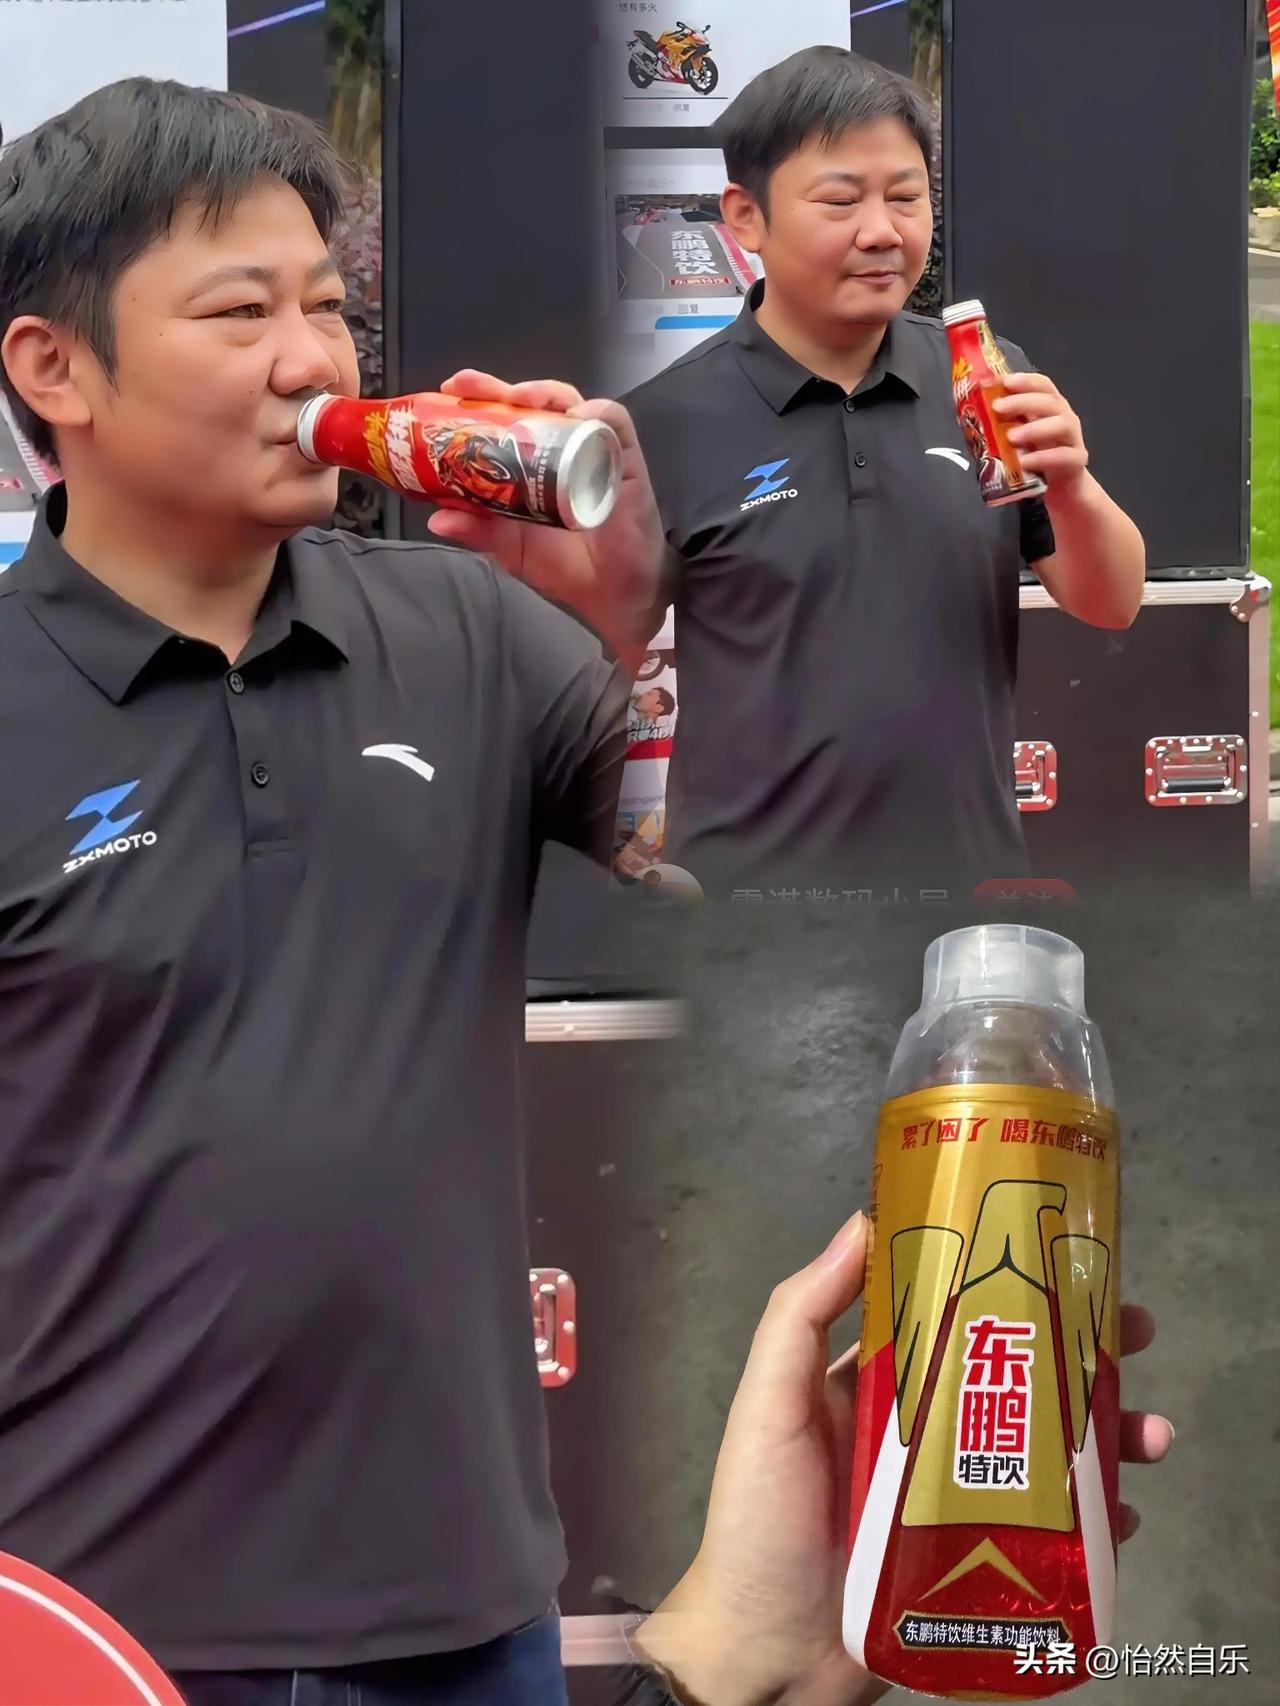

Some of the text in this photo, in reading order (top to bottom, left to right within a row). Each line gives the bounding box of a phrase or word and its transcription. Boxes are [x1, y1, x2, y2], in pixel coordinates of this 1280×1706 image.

[740, 489, 798, 511] ZXMOTO
[62, 831, 158, 874] ZXMOTO
[901, 1117, 1107, 1161] 累了困了 喝东鹏特饮
[959, 1454, 1025, 1485] 特饮
[904, 1620, 1061, 1648] 东鹏特饮维生素功能饮料
